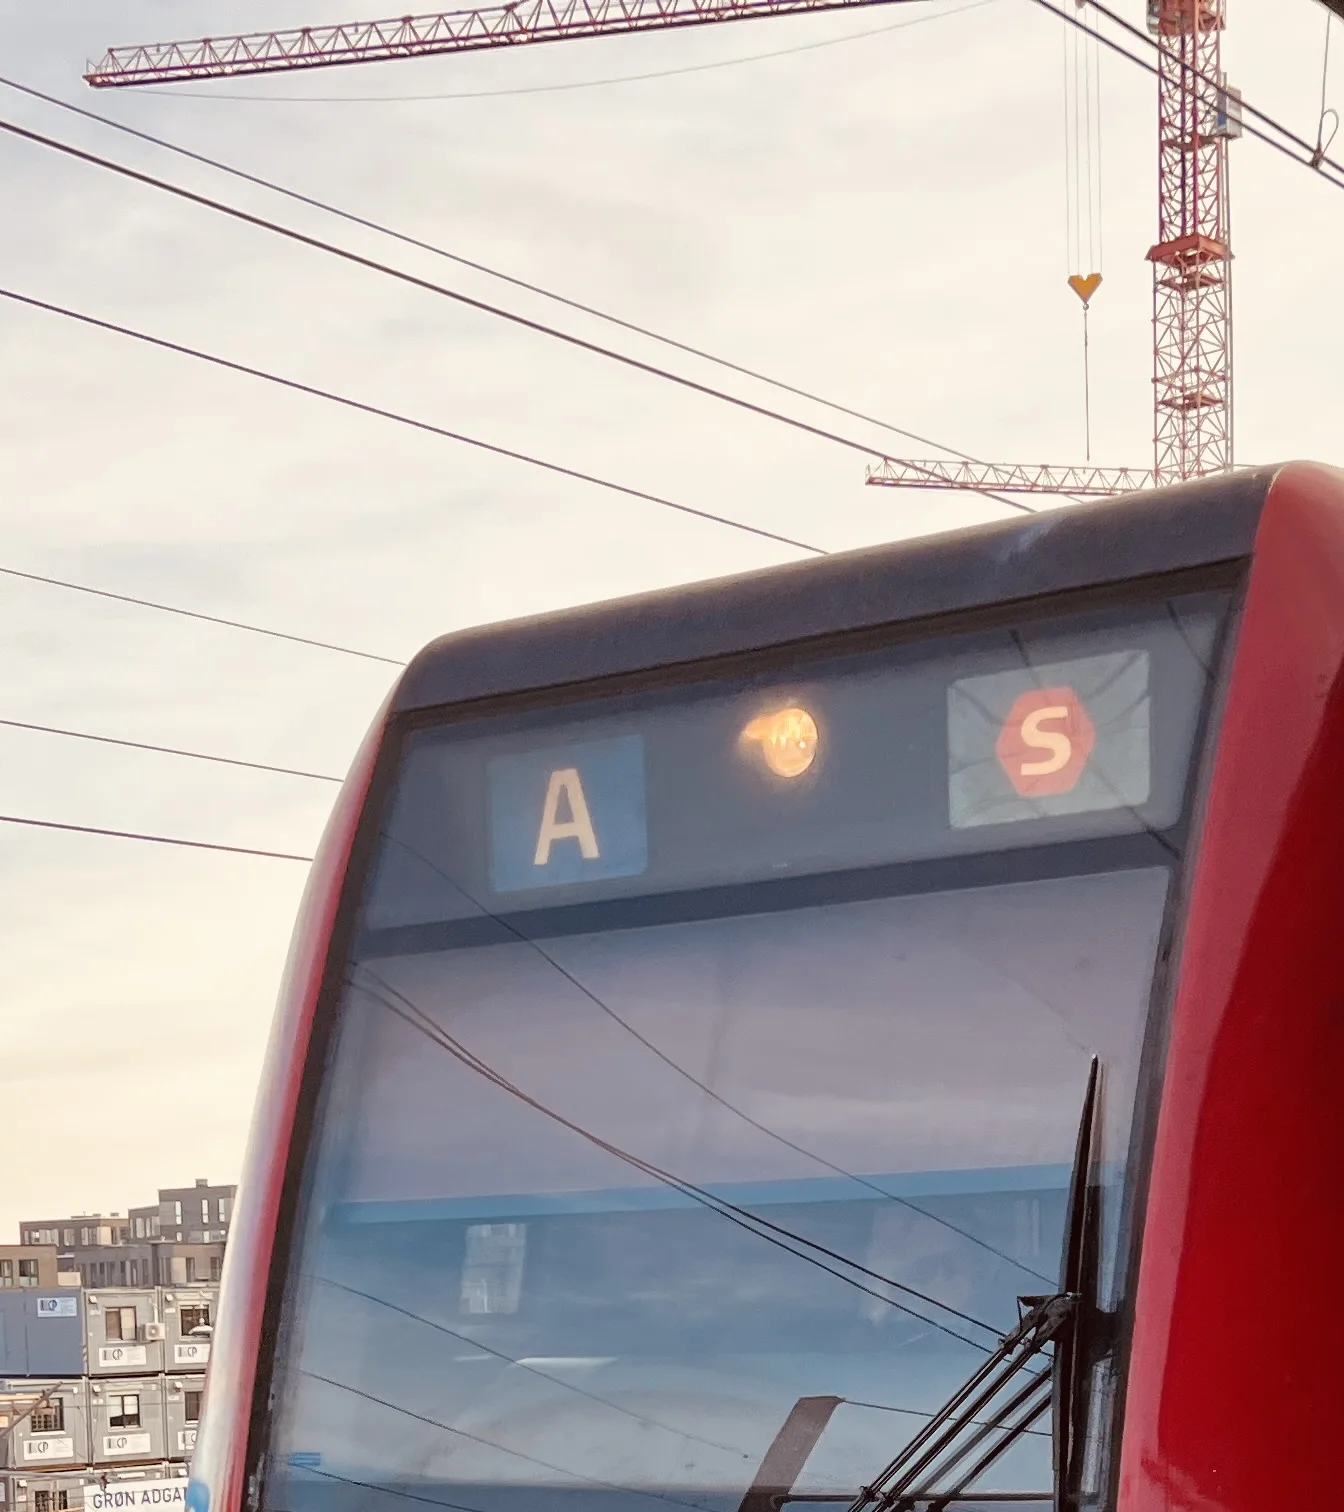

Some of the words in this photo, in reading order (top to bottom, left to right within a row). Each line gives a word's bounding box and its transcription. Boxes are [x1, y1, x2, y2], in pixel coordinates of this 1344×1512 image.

[1020, 706, 1070, 777] S
[533, 768, 600, 866] A
[93, 1490, 136, 1509] GRØN
